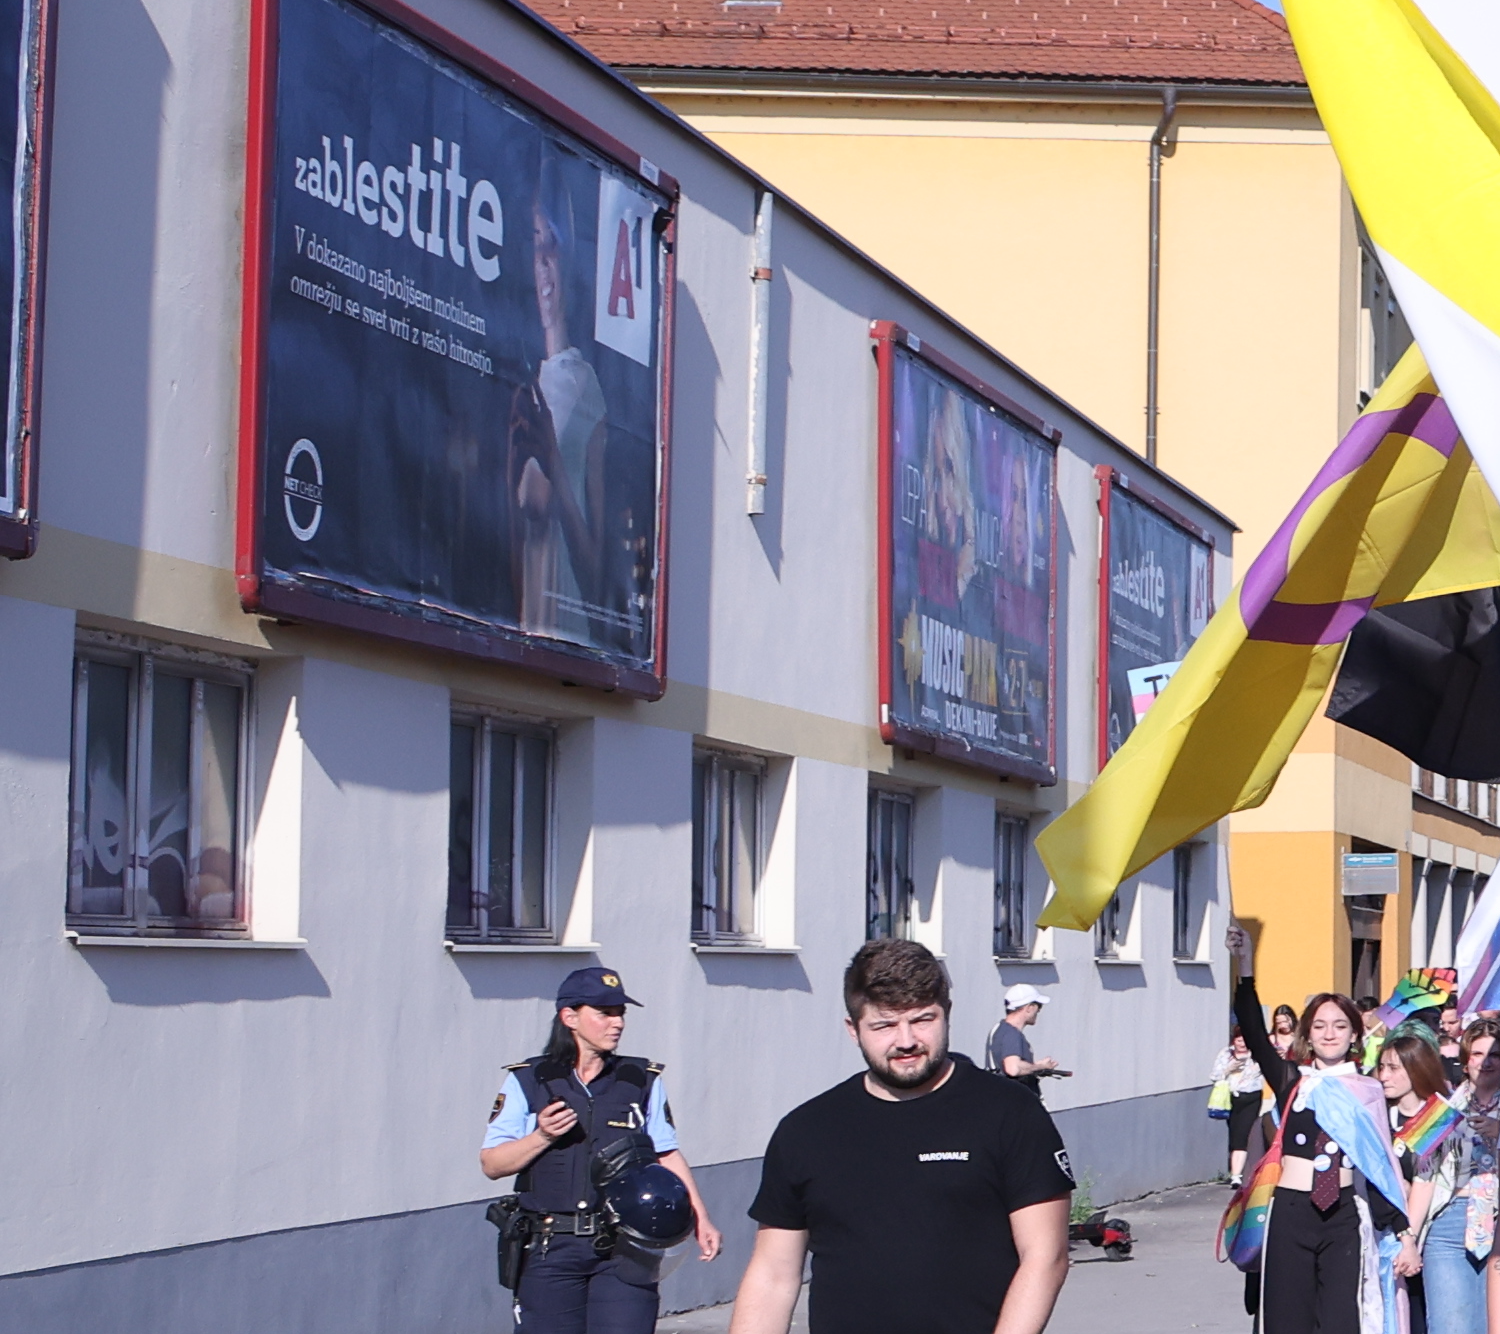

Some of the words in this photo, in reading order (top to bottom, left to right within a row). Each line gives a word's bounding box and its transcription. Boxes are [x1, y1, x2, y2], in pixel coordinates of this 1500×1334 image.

[294, 134, 504, 282] zablestite
[290, 275, 342, 315] omrežju
[345, 297, 360, 319] se
[362, 306, 388, 332] svet
[389, 314, 410, 342] vrti
[412, 328, 420, 345] z
[421, 328, 447, 356] vašo
[294, 224, 305, 255] V
[307, 233, 367, 284] dokazano
[368, 268, 433, 313] najboljšem
[434, 296, 487, 336] mobilnem
[607, 216, 643, 320] A1
[918, 1151, 970, 1162] VAROVANJE
